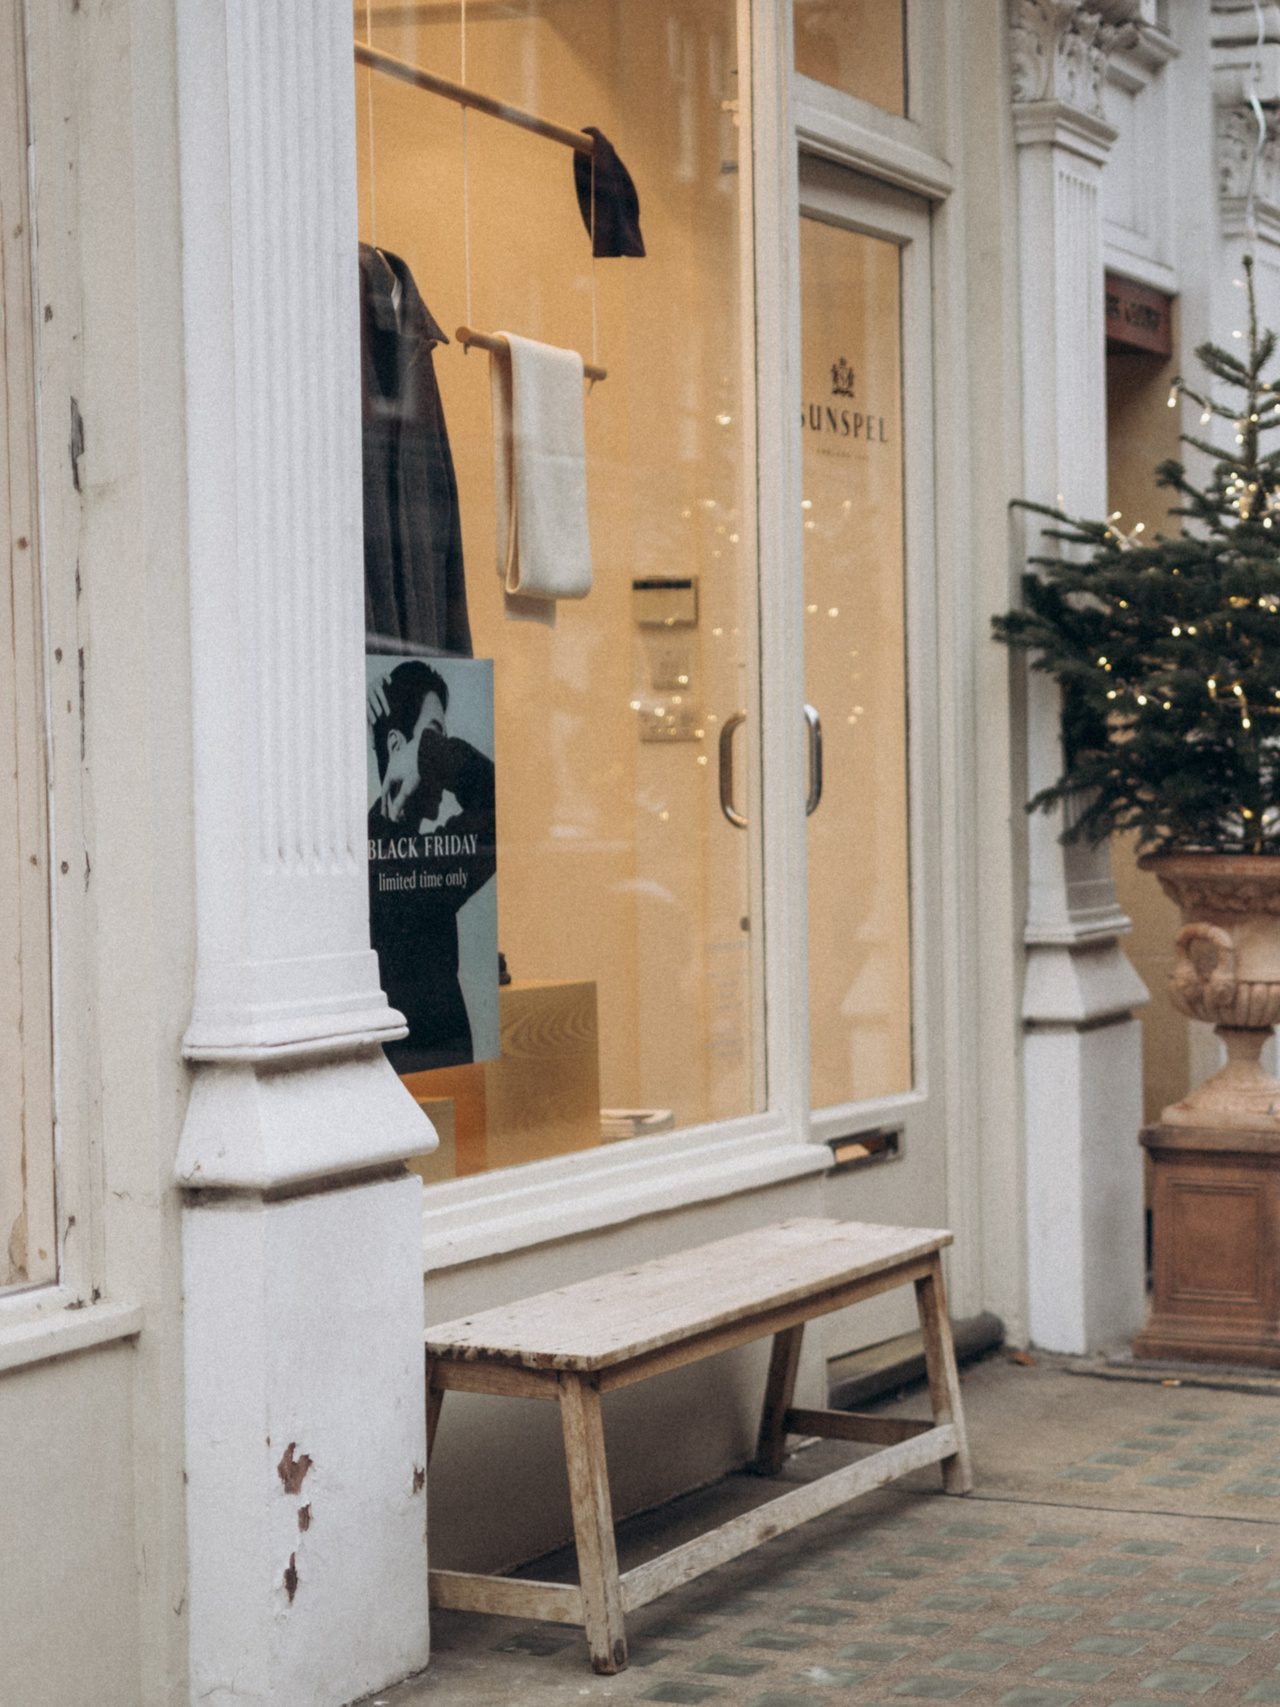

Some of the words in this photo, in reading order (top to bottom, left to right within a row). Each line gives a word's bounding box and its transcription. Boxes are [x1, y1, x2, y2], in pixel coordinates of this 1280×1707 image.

[368, 836, 419, 860] BLACK
[424, 833, 478, 857] FRIDAY
[378, 870, 417, 891] limited
[419, 870, 442, 888] time
[445, 866, 469, 889] only
